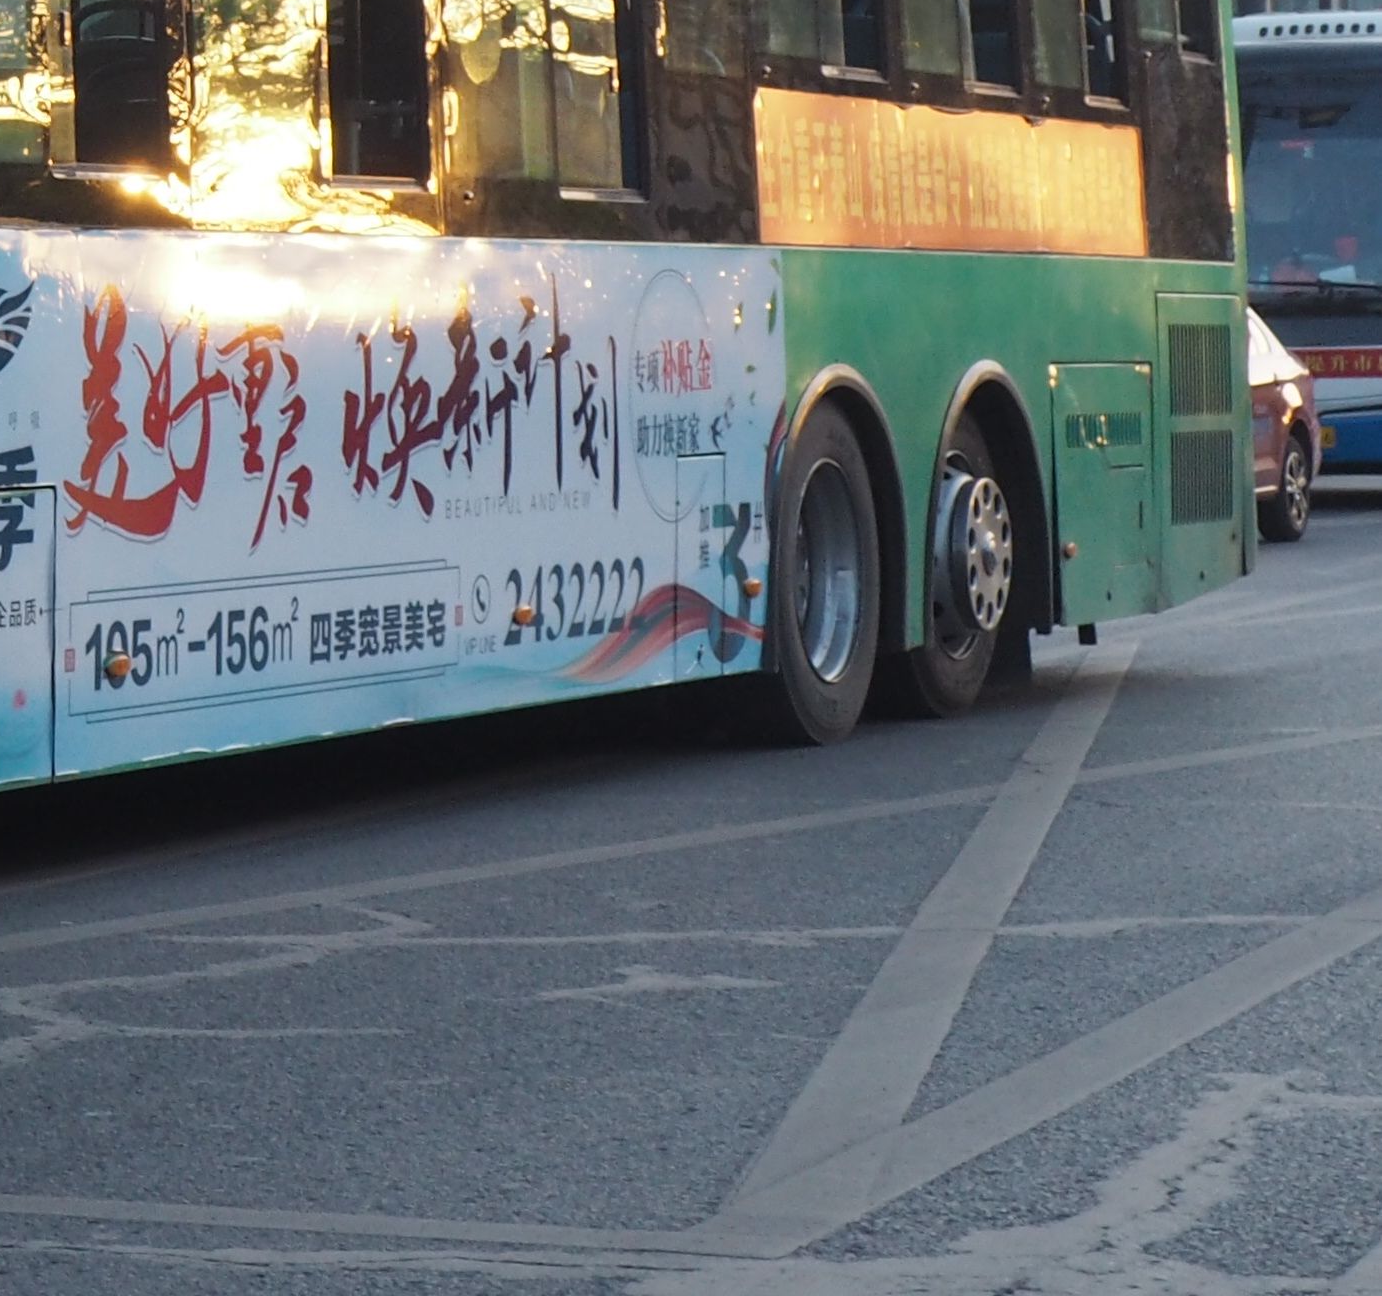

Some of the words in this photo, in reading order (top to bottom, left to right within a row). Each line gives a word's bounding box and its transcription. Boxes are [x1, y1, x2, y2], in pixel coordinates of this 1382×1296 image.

[530, 492, 557, 512] AND
[310, 597, 446, 665] 四季宽景美宅
[503, 556, 645, 646] 2432222
